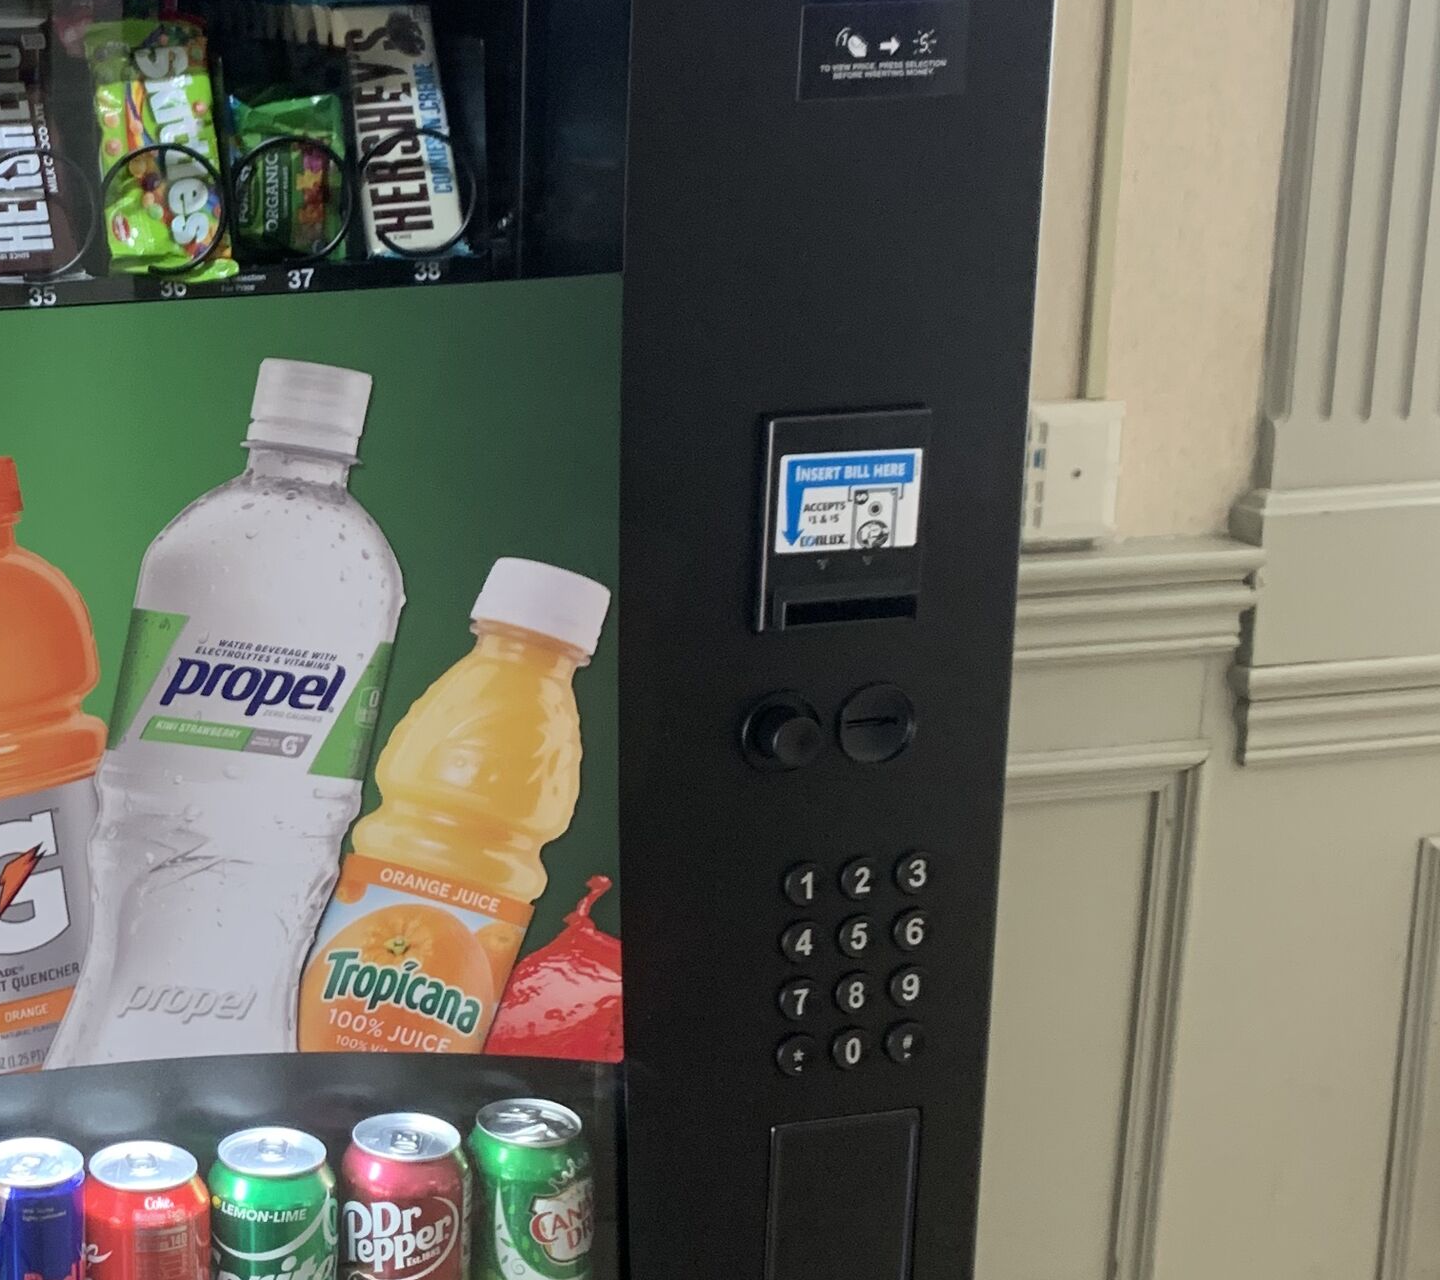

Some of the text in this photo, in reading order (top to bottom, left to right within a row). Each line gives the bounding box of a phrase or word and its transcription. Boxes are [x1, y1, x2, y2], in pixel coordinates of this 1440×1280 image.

[820, 64, 830, 73] TO
[832, 63, 851, 72] VIEW
[878, 61, 903, 69] PRESS
[905, 59, 948, 68] SELECTION
[832, 67, 935, 80] BEFORE INSERTING MONEY
[265, 151, 279, 232] ORGANIC
[287, 268, 314, 289] 37
[414, 262, 441, 281] 38
[29, 285, 57, 306] 35
[795, 462, 907, 483] INSERT BILL HERE
[803, 501, 846, 513] ACCEPTS
[195, 646, 271, 664] ELECTROLYTES
[284, 656, 331, 670] VITAMINS
[218, 639, 337, 662] WATER BEVERAGE WITH
[159, 657, 347, 717] propel
[155, 720, 242, 739] KIWI STRAWBERRY
[800, 870, 814, 900] 1
[854, 866, 871, 894] 2
[908, 859, 927, 888] 3
[380, 867, 502, 914] ORANGE JUICE
[794, 928, 813, 956] 4
[850, 922, 868, 951] 5
[906, 917, 925, 946] 6
[12, 962, 80, 992] QUENCHER
[901, 973, 921, 1001] 9
[117, 983, 257, 1022] propel
[323, 949, 482, 1035] Tropicana
[793, 987, 809, 1016] 7
[848, 981, 865, 1009] 8
[4, 1002, 49, 1023] ORANGE
[328, 1007, 452, 1053] 100% JUICE
[845, 1037, 861, 1064] 0
[144, 1196, 171, 1211] Coke
[220, 1200, 308, 1223] LEMON-LIME
